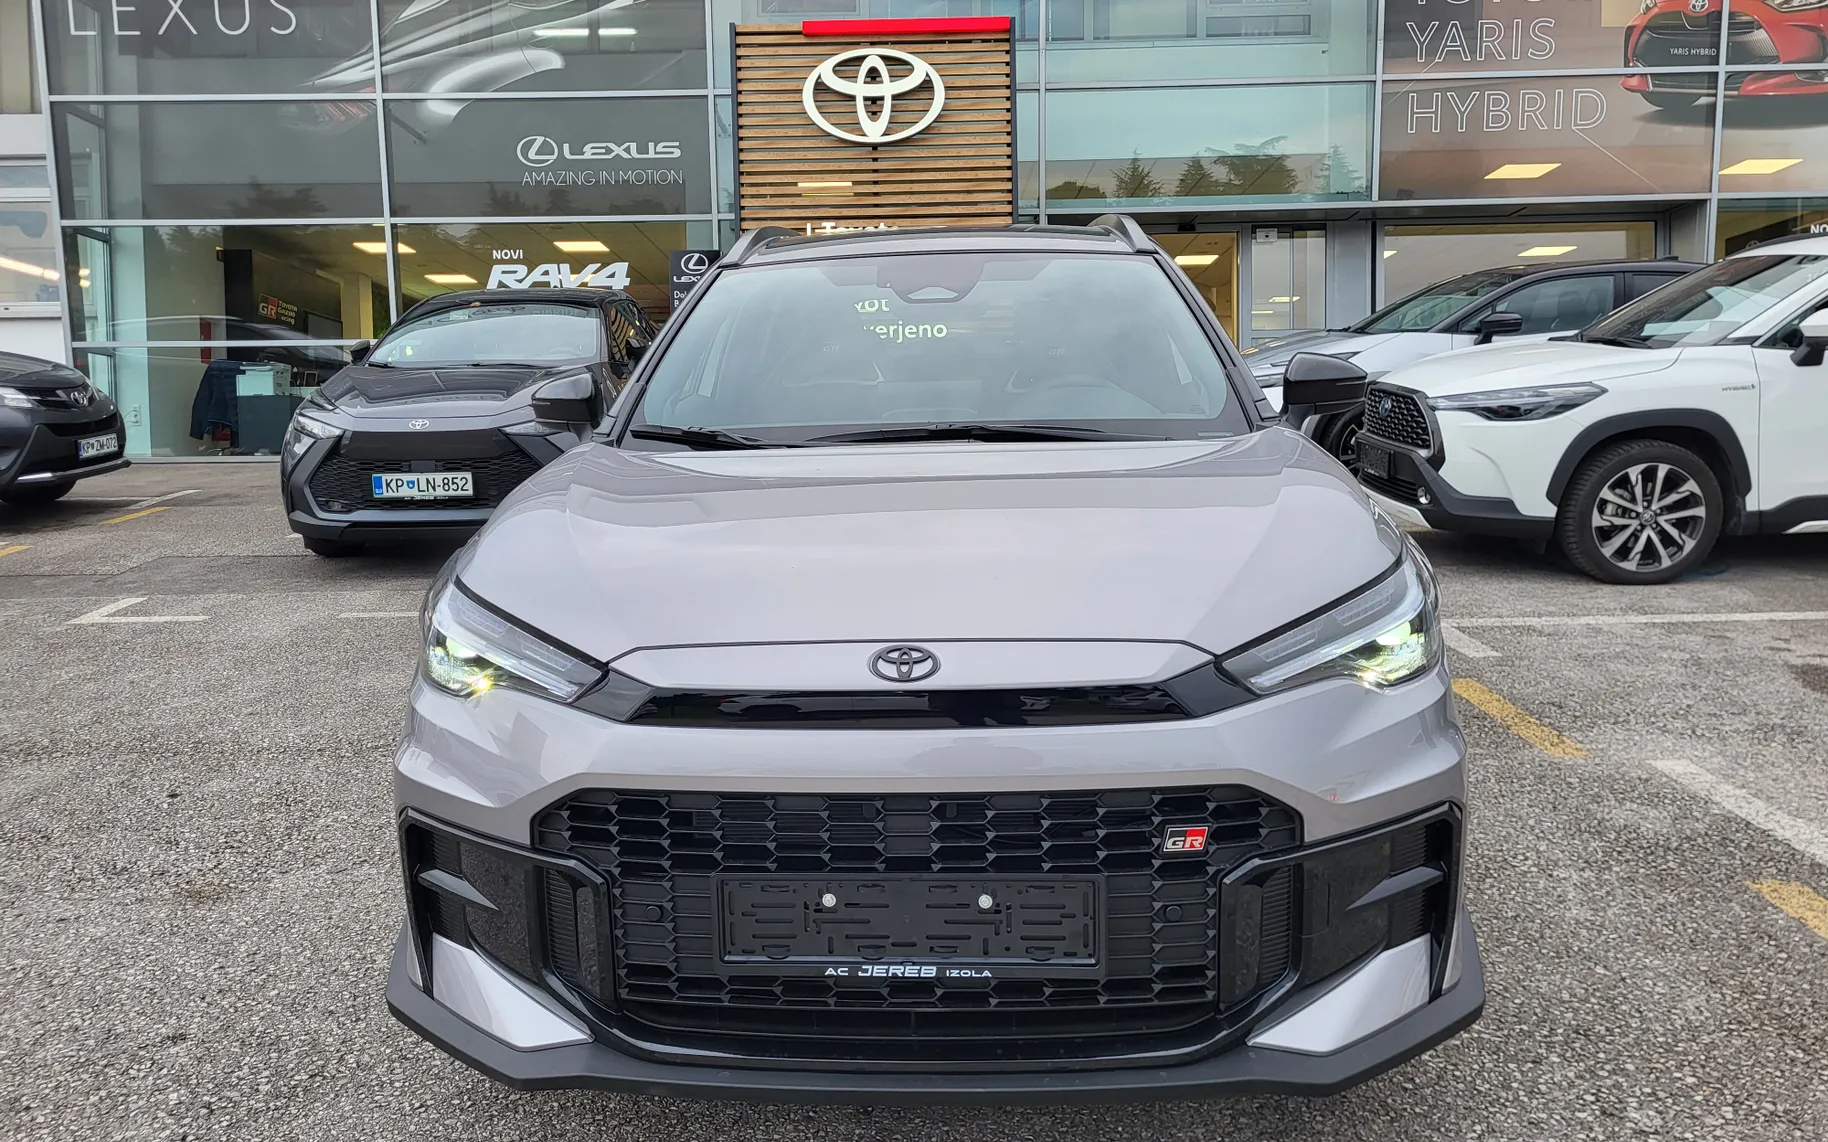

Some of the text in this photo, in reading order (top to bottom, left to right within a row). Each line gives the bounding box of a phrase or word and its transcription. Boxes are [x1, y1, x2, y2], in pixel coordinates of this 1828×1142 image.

[68, 0, 297, 35] LEXUS
[1406, 17, 1556, 63] YARIS
[1670, 47, 1717, 56] YARIS HYBRID
[1407, 88, 1607, 134] HYBRID
[563, 141, 682, 160] LEXUS
[521, 169, 683, 186] AMAZING IN MOTION
[1810, 223, 1828, 234] NO
[492, 249, 524, 260] NOVI
[485, 262, 630, 291] RAV4
[673, 275, 701, 283] LEX
[259, 302, 276, 317] GR
[82, 441, 91, 454] KP
[385, 478, 404, 494] KP
[416, 477, 469, 493] LN-852
[1166, 836, 1204, 849] GR
[824, 965, 993, 977] AC JEREB IZOLA
